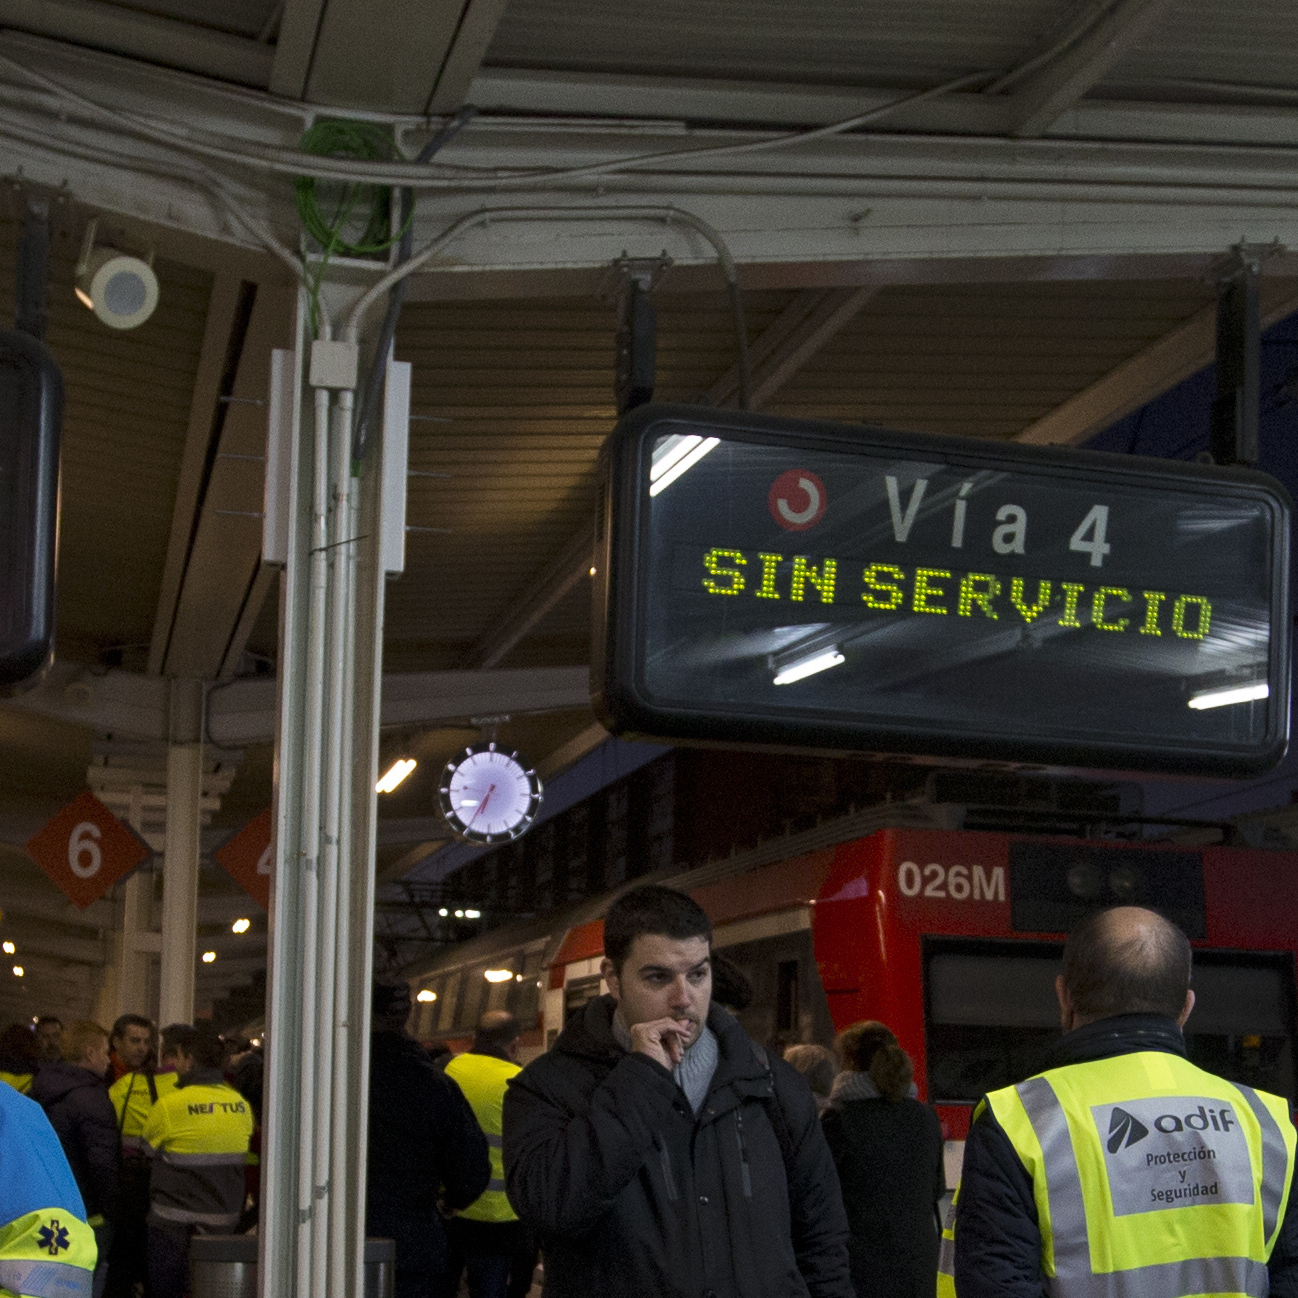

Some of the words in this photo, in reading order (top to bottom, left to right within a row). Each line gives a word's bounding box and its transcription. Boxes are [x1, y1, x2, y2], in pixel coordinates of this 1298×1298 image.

[884, 475, 1026, 554] Vía
[1069, 503, 1111, 567] 4
[702, 546, 837, 604] SIN
[862, 562, 1214, 640] SERVICIO
[67, 822, 103, 878] 6
[898, 861, 1005, 902] 026M
[1154, 1105, 1234, 1134] adif
[1146, 1146, 1216, 1166] Protección
[1151, 1182, 1219, 1203] Seguridad
[1178, 1170, 1187, 1183] y
